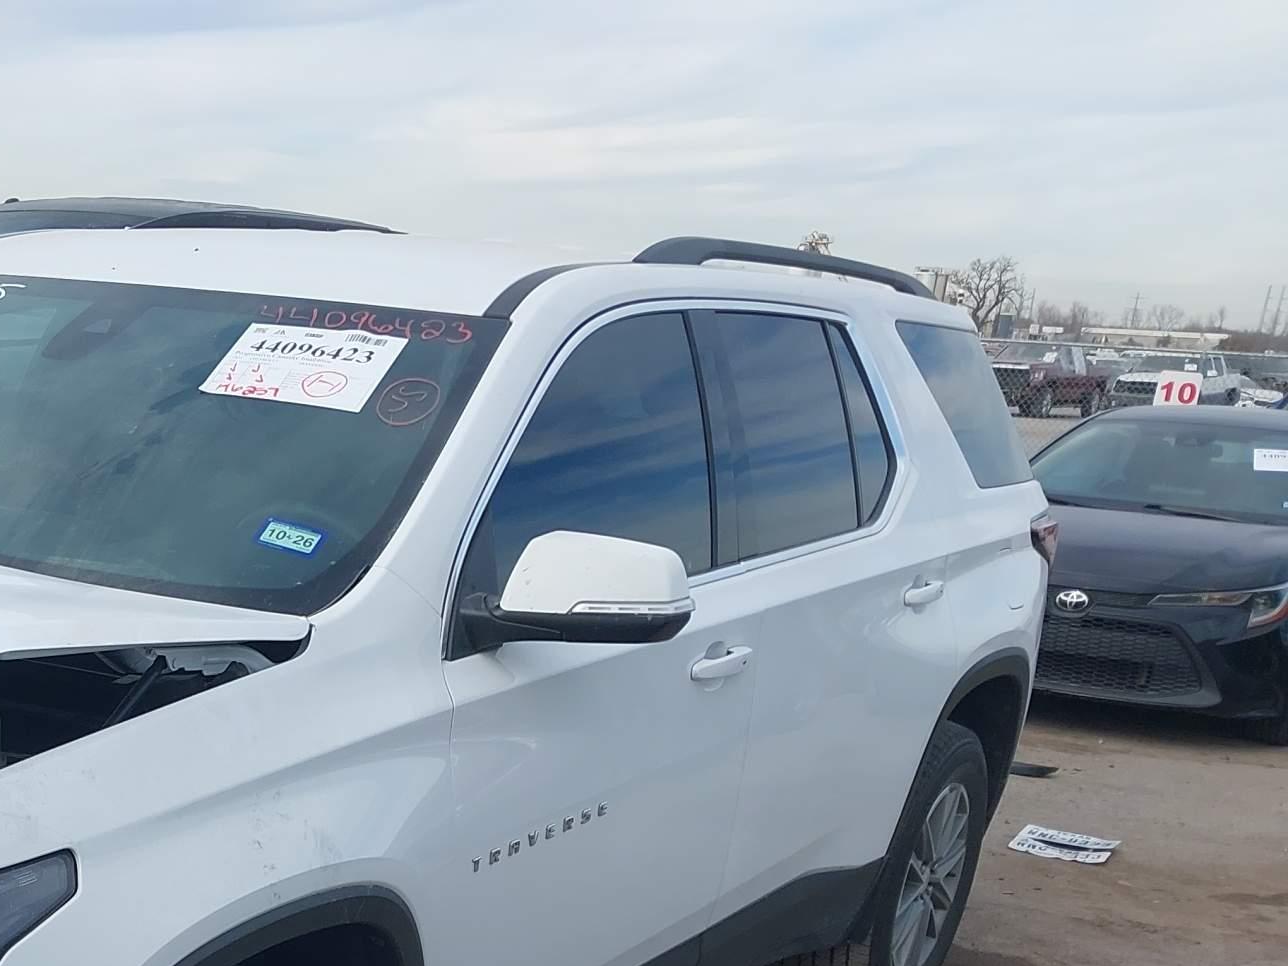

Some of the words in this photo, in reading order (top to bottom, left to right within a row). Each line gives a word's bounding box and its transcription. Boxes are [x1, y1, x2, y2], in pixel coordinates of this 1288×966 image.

[260, 304, 473, 343] 44096423
[250, 338, 376, 364] 44096423
[1160, 380, 1198, 405] 10
[471, 800, 609, 874] TRAVERSE
